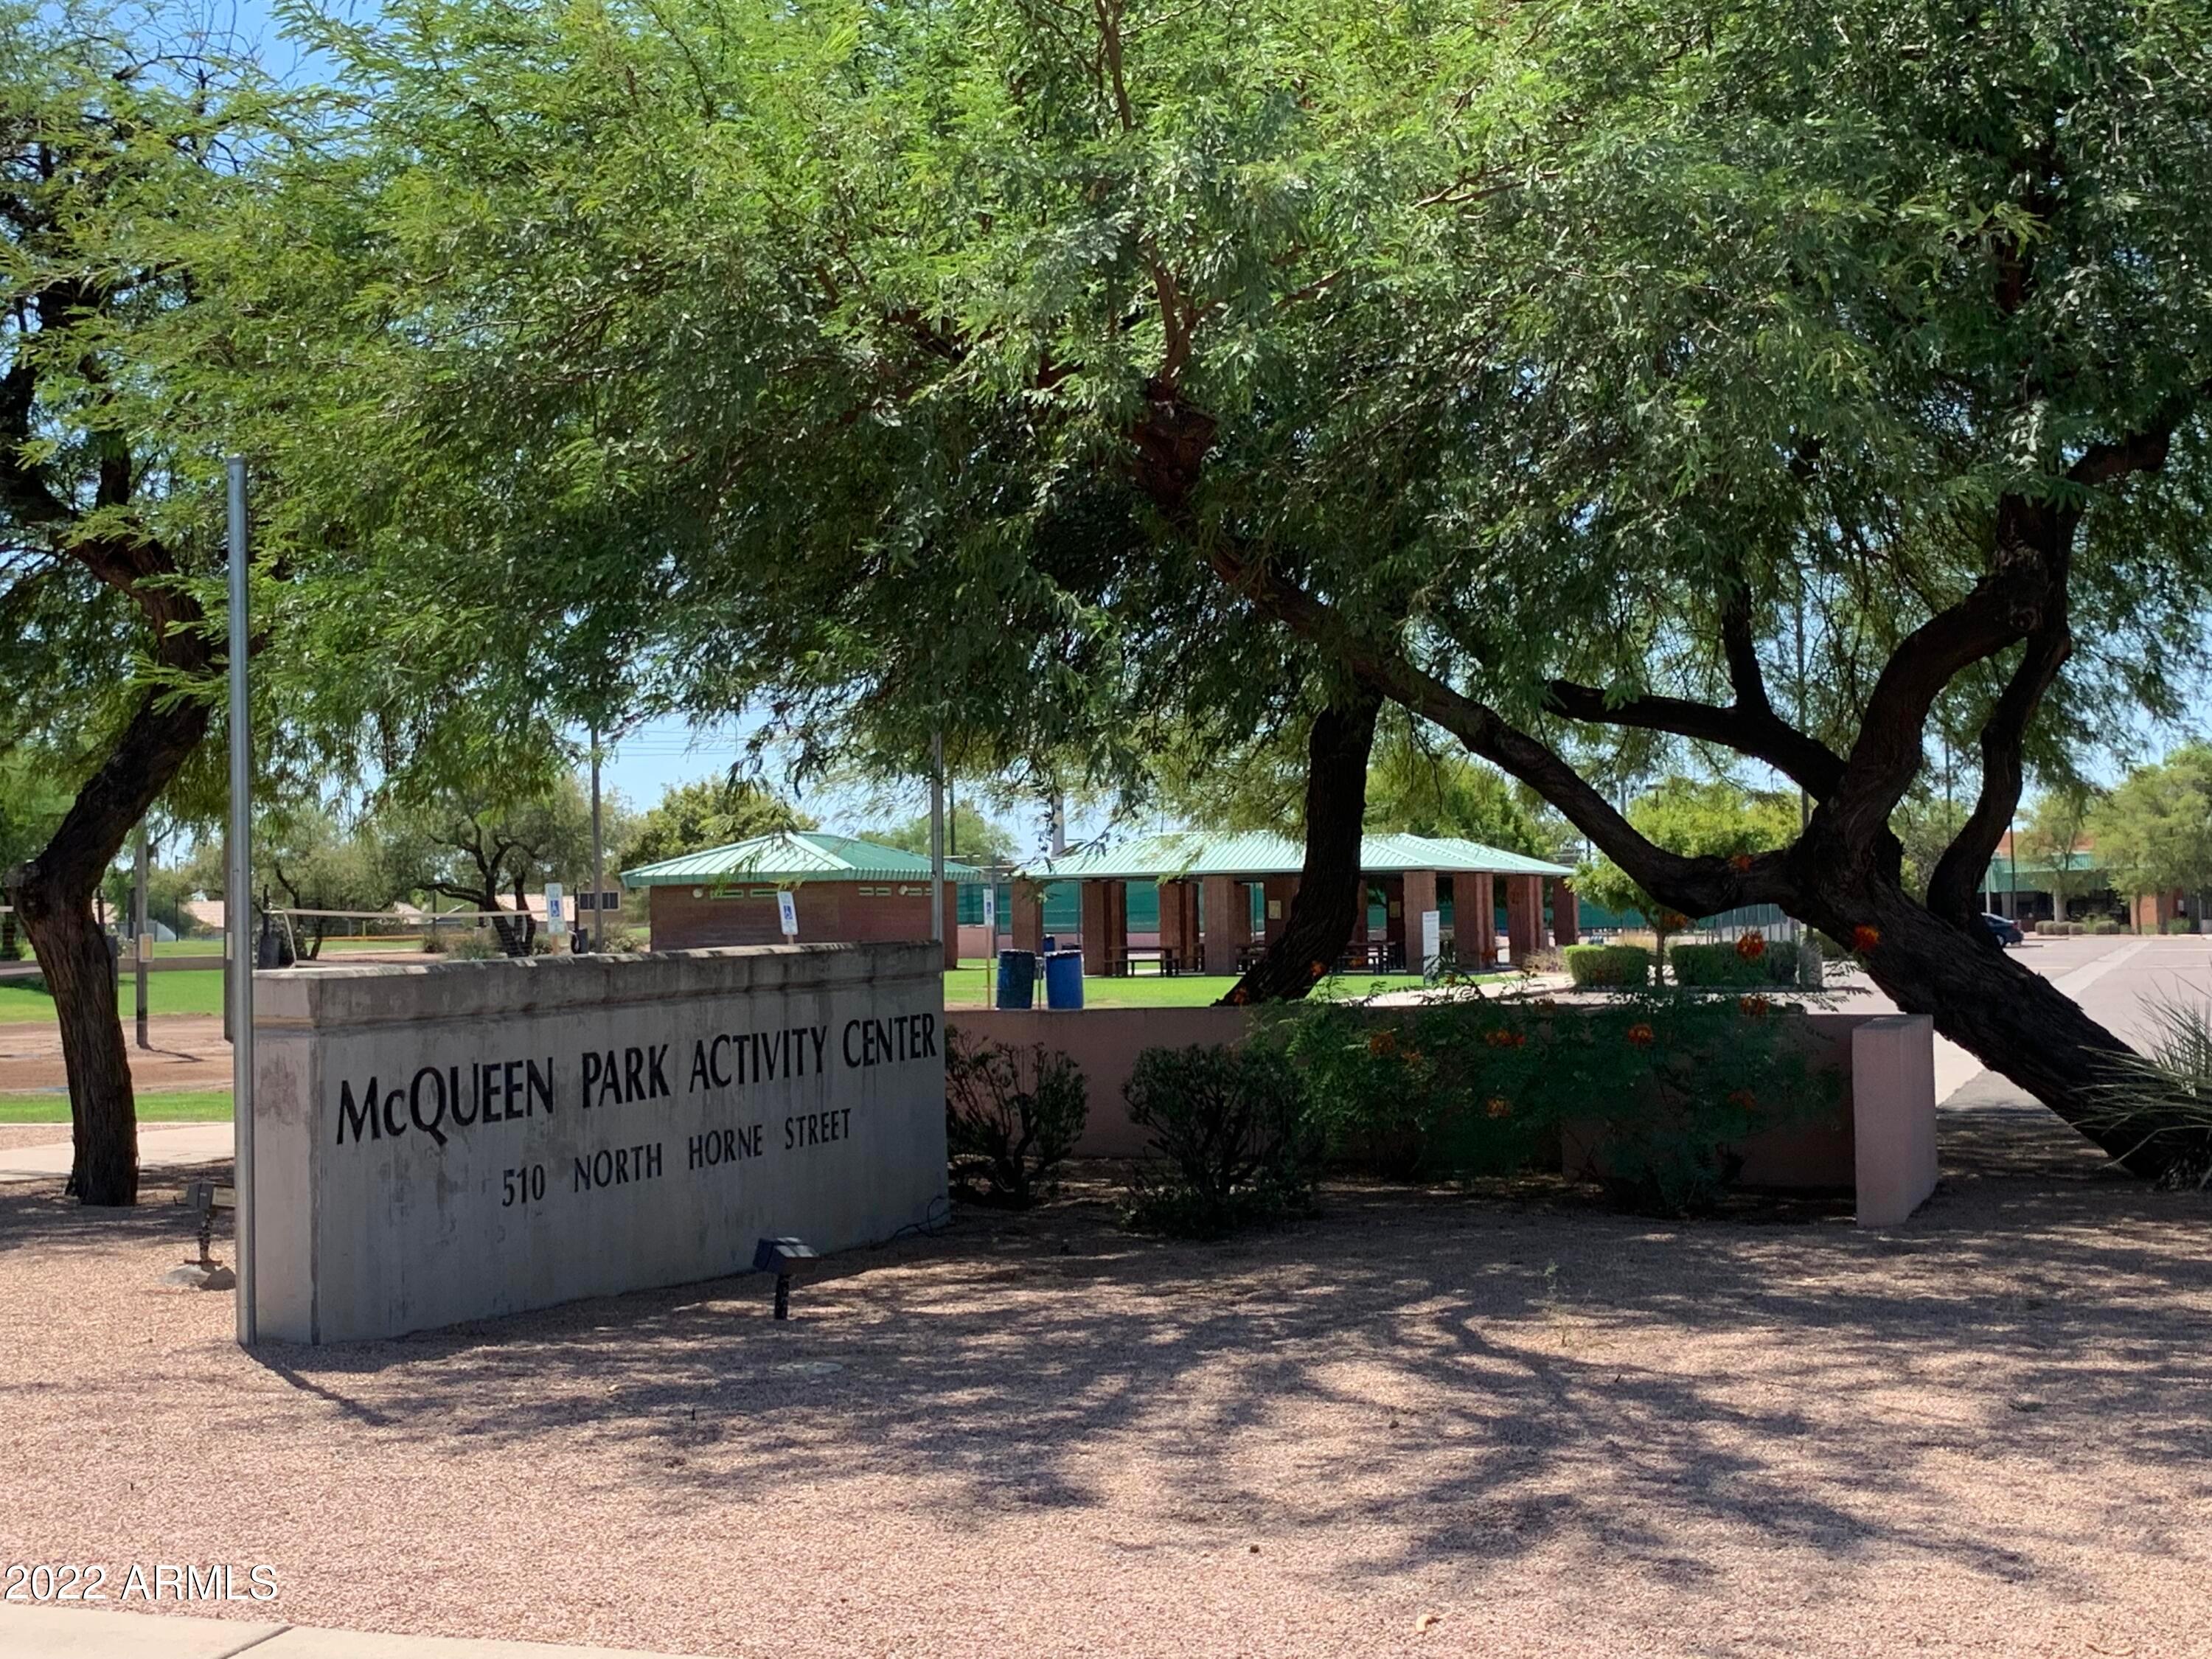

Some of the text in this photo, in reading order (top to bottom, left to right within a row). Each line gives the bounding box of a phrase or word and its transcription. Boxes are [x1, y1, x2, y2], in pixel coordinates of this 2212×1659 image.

[336, 1013, 937, 1147] McQUEEN PARK ACTIVITY CENTER
[501, 1108, 852, 1208] 510 NORTH HORNE STREET
